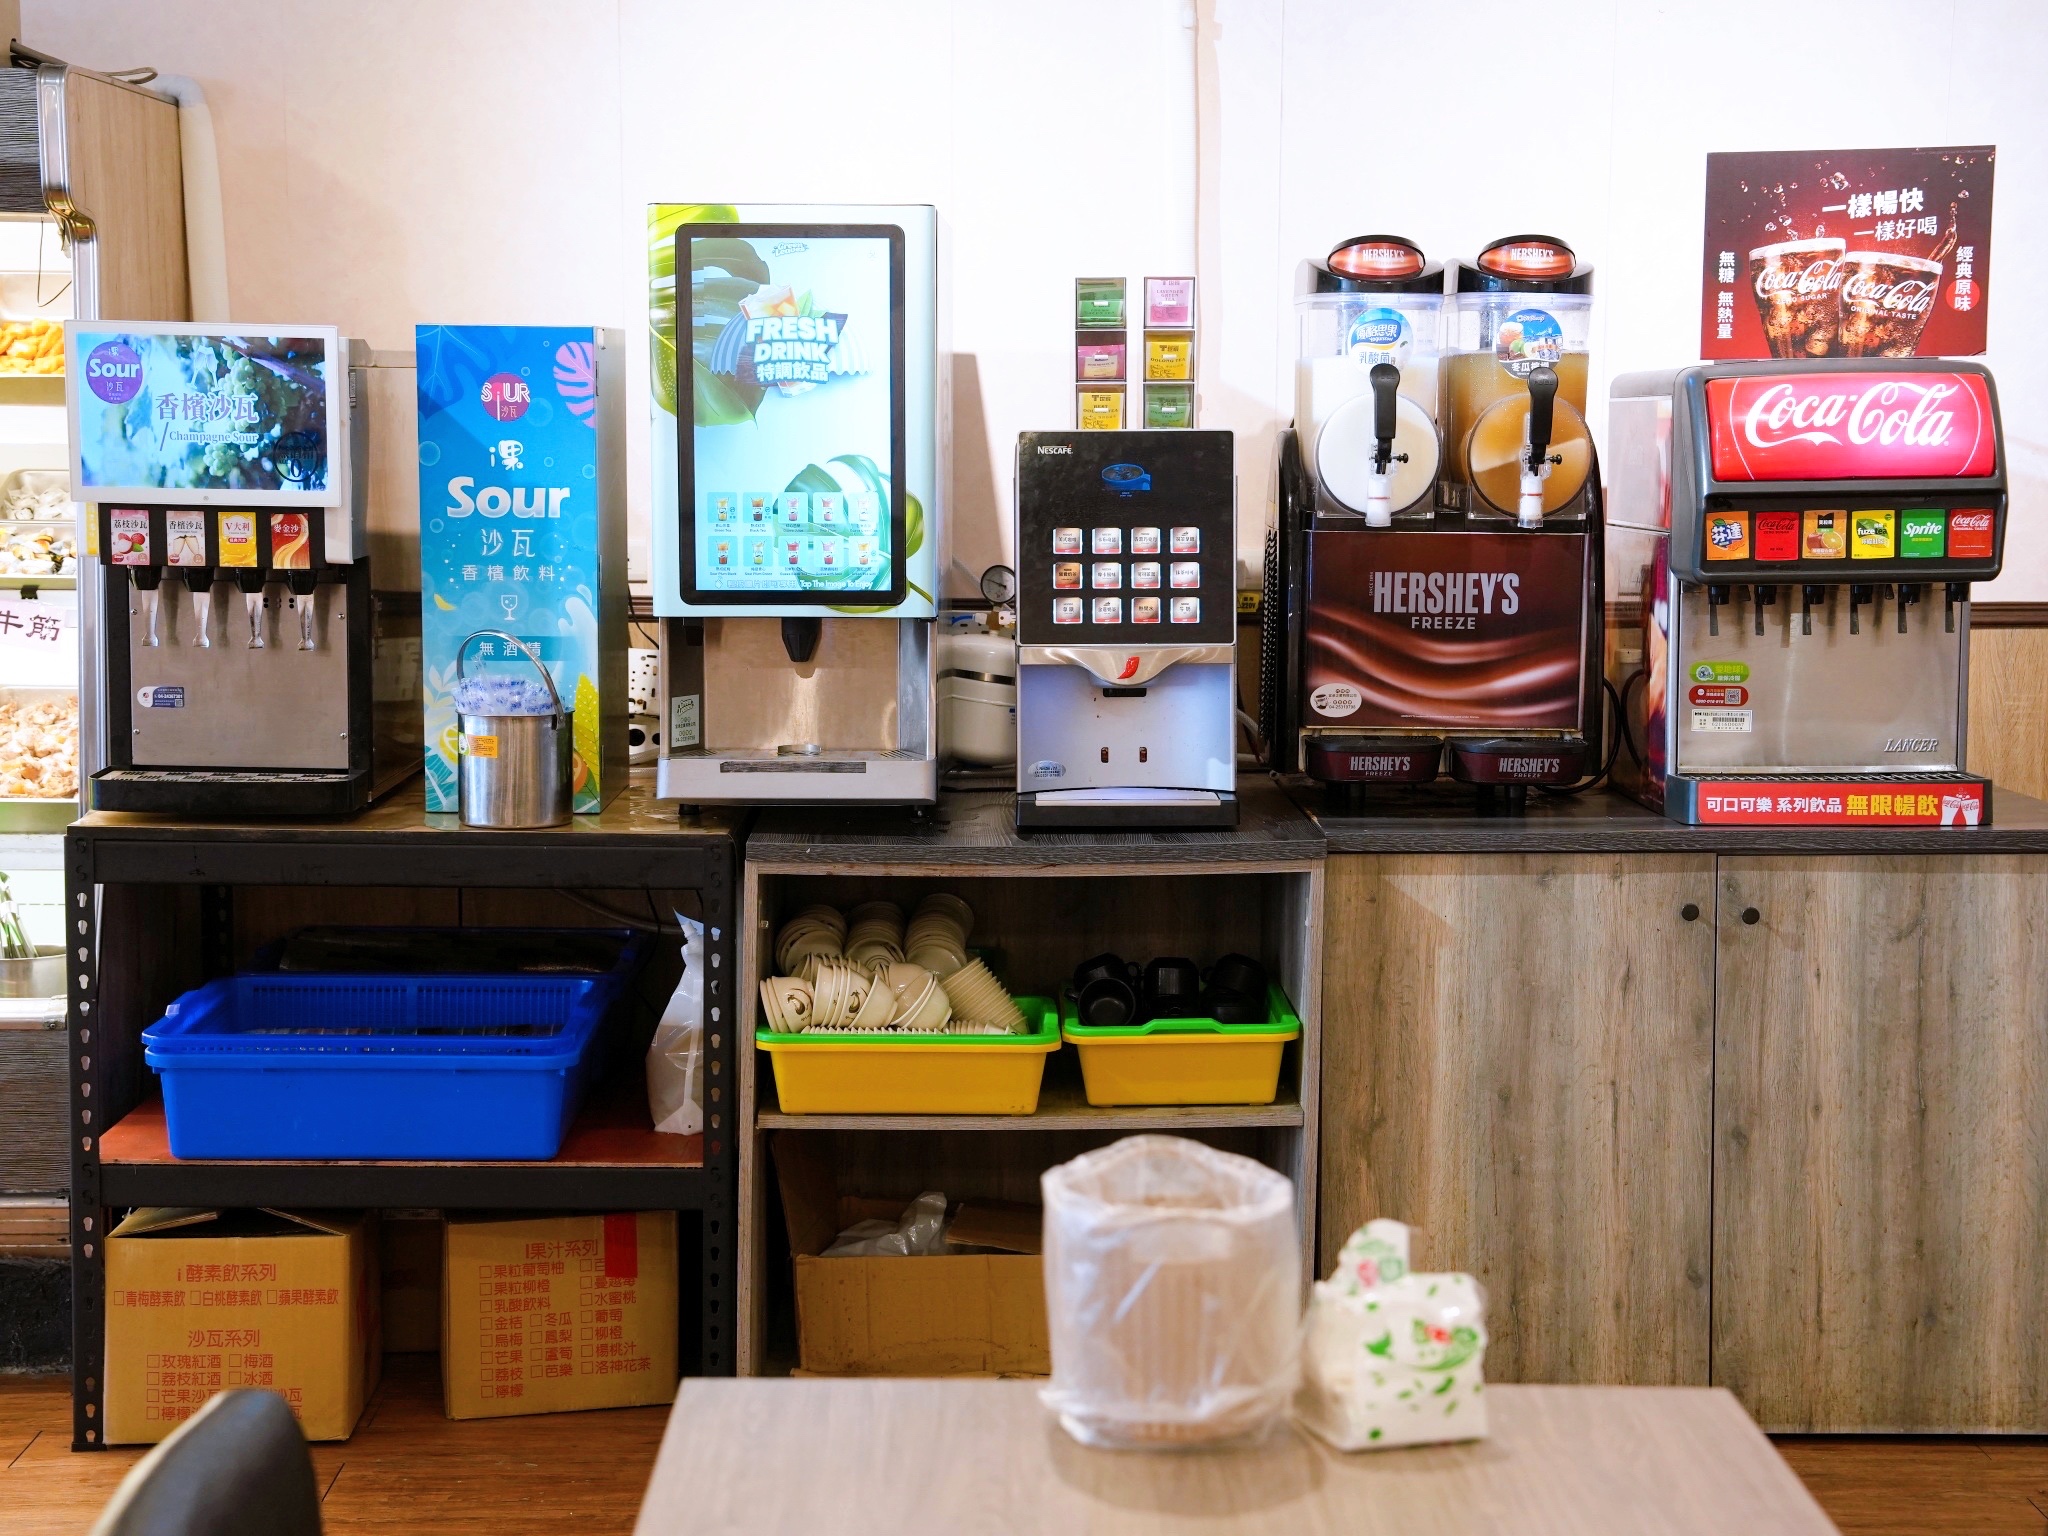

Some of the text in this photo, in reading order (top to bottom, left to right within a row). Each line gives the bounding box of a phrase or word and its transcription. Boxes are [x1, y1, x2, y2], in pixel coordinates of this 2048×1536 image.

[1822, 187, 1924, 219] 一樣暢快
[1854, 216, 1938, 242] 一樣好喝
[1362, 249, 1405, 261] HERSHEY'S
[1511, 248, 1553, 261] HERSHEY'S
[1954, 246, 1974, 312] 經典原味
[1716, 251, 1736, 339] 無糖 無熱量
[1800, 293, 1828, 301] SUGAR
[1842, 270, 1938, 313] Coca-Cola
[1850, 305, 1917, 320] ORIGINAL TASTE
[746, 317, 839, 343] FRESH
[754, 342, 831, 363] DRINK
[90, 358, 140, 378] Sour
[756, 363, 829, 382] 特調飲品
[106, 381, 124, 392] 沙瓦
[155, 393, 259, 422] 香檳沙瓦
[501, 405, 517, 418] 沙瓦
[1745, 382, 1960, 448] Coca-Cola
[169, 430, 259, 444] Champagne Sour
[447, 476, 571, 518] Sour
[114, 520, 148, 529] 荔枝沙瓦
[169, 521, 203, 530] 香檳沙瓦
[1758, 518, 1796, 531] Coca-Cola
[1951, 514, 1992, 527] Coca-Cola
[1711, 522, 1743, 545] 芬達
[1857, 527, 1887, 535] fuzetea
[1903, 521, 1942, 537] Sprite
[481, 529, 535, 557] 沙瓦
[462, 565, 555, 581] 香檳飲料
[800, 580, 812, 588] Tap
[826, 580, 846, 589] Image
[856, 580, 873, 589] Enjoy
[1373, 571, 1520, 615] HERSHEY'S
[1411, 616, 1476, 630] FREEZE
[479, 641, 541, 656] 無酒精
[1884, 738, 1939, 753] LANCER
[1350, 756, 1411, 771] HERSHEY'S
[1499, 757, 1560, 773] HERSHEY'S
[1706, 797, 1772, 813] 可口可樂
[1776, 797, 1842, 813] 系列飲品
[1846, 794, 1939, 816] 無限暢飲
[494, 1261, 564, 1278] 果粒葡萄柚
[494, 1279, 550, 1295] 果粒柳橙
[125, 1291, 185, 1307] 青梅酵素飲
[202, 1290, 262, 1306] 白桃酵素飲
[278, 1289, 339, 1305] 蘋果酵素飲
[494, 1296, 551, 1313] 乳酸飲料
[595, 1290, 636, 1305] 水蜜桃
[495, 1316, 523, 1331] 金桔
[545, 1312, 572, 1326] 冬瓜
[595, 1309, 623, 1323] 葡萄
[188, 1329, 260, 1348] 沙瓦系列
[495, 1333, 523, 1348] 烏梅
[545, 1329, 572, 1345] 鳳梨
[595, 1326, 623, 1340] 柳橙
[545, 1346, 572, 1361] 蘆筍
[596, 1342, 637, 1357] 楊桃汁
[161, 1354, 221, 1369] 玫瑰紅酒
[243, 1354, 273, 1368] 梅酒
[495, 1350, 523, 1365] 芒果
[545, 1364, 573, 1378] 芭樂
[596, 1357, 651, 1375] 洛神花茶
[161, 1371, 221, 1386] 荔枝紅酒
[243, 1371, 273, 1385] 冰酒
[496, 1367, 523, 1382] 荔枝
[496, 1384, 524, 1398] 檸檬
